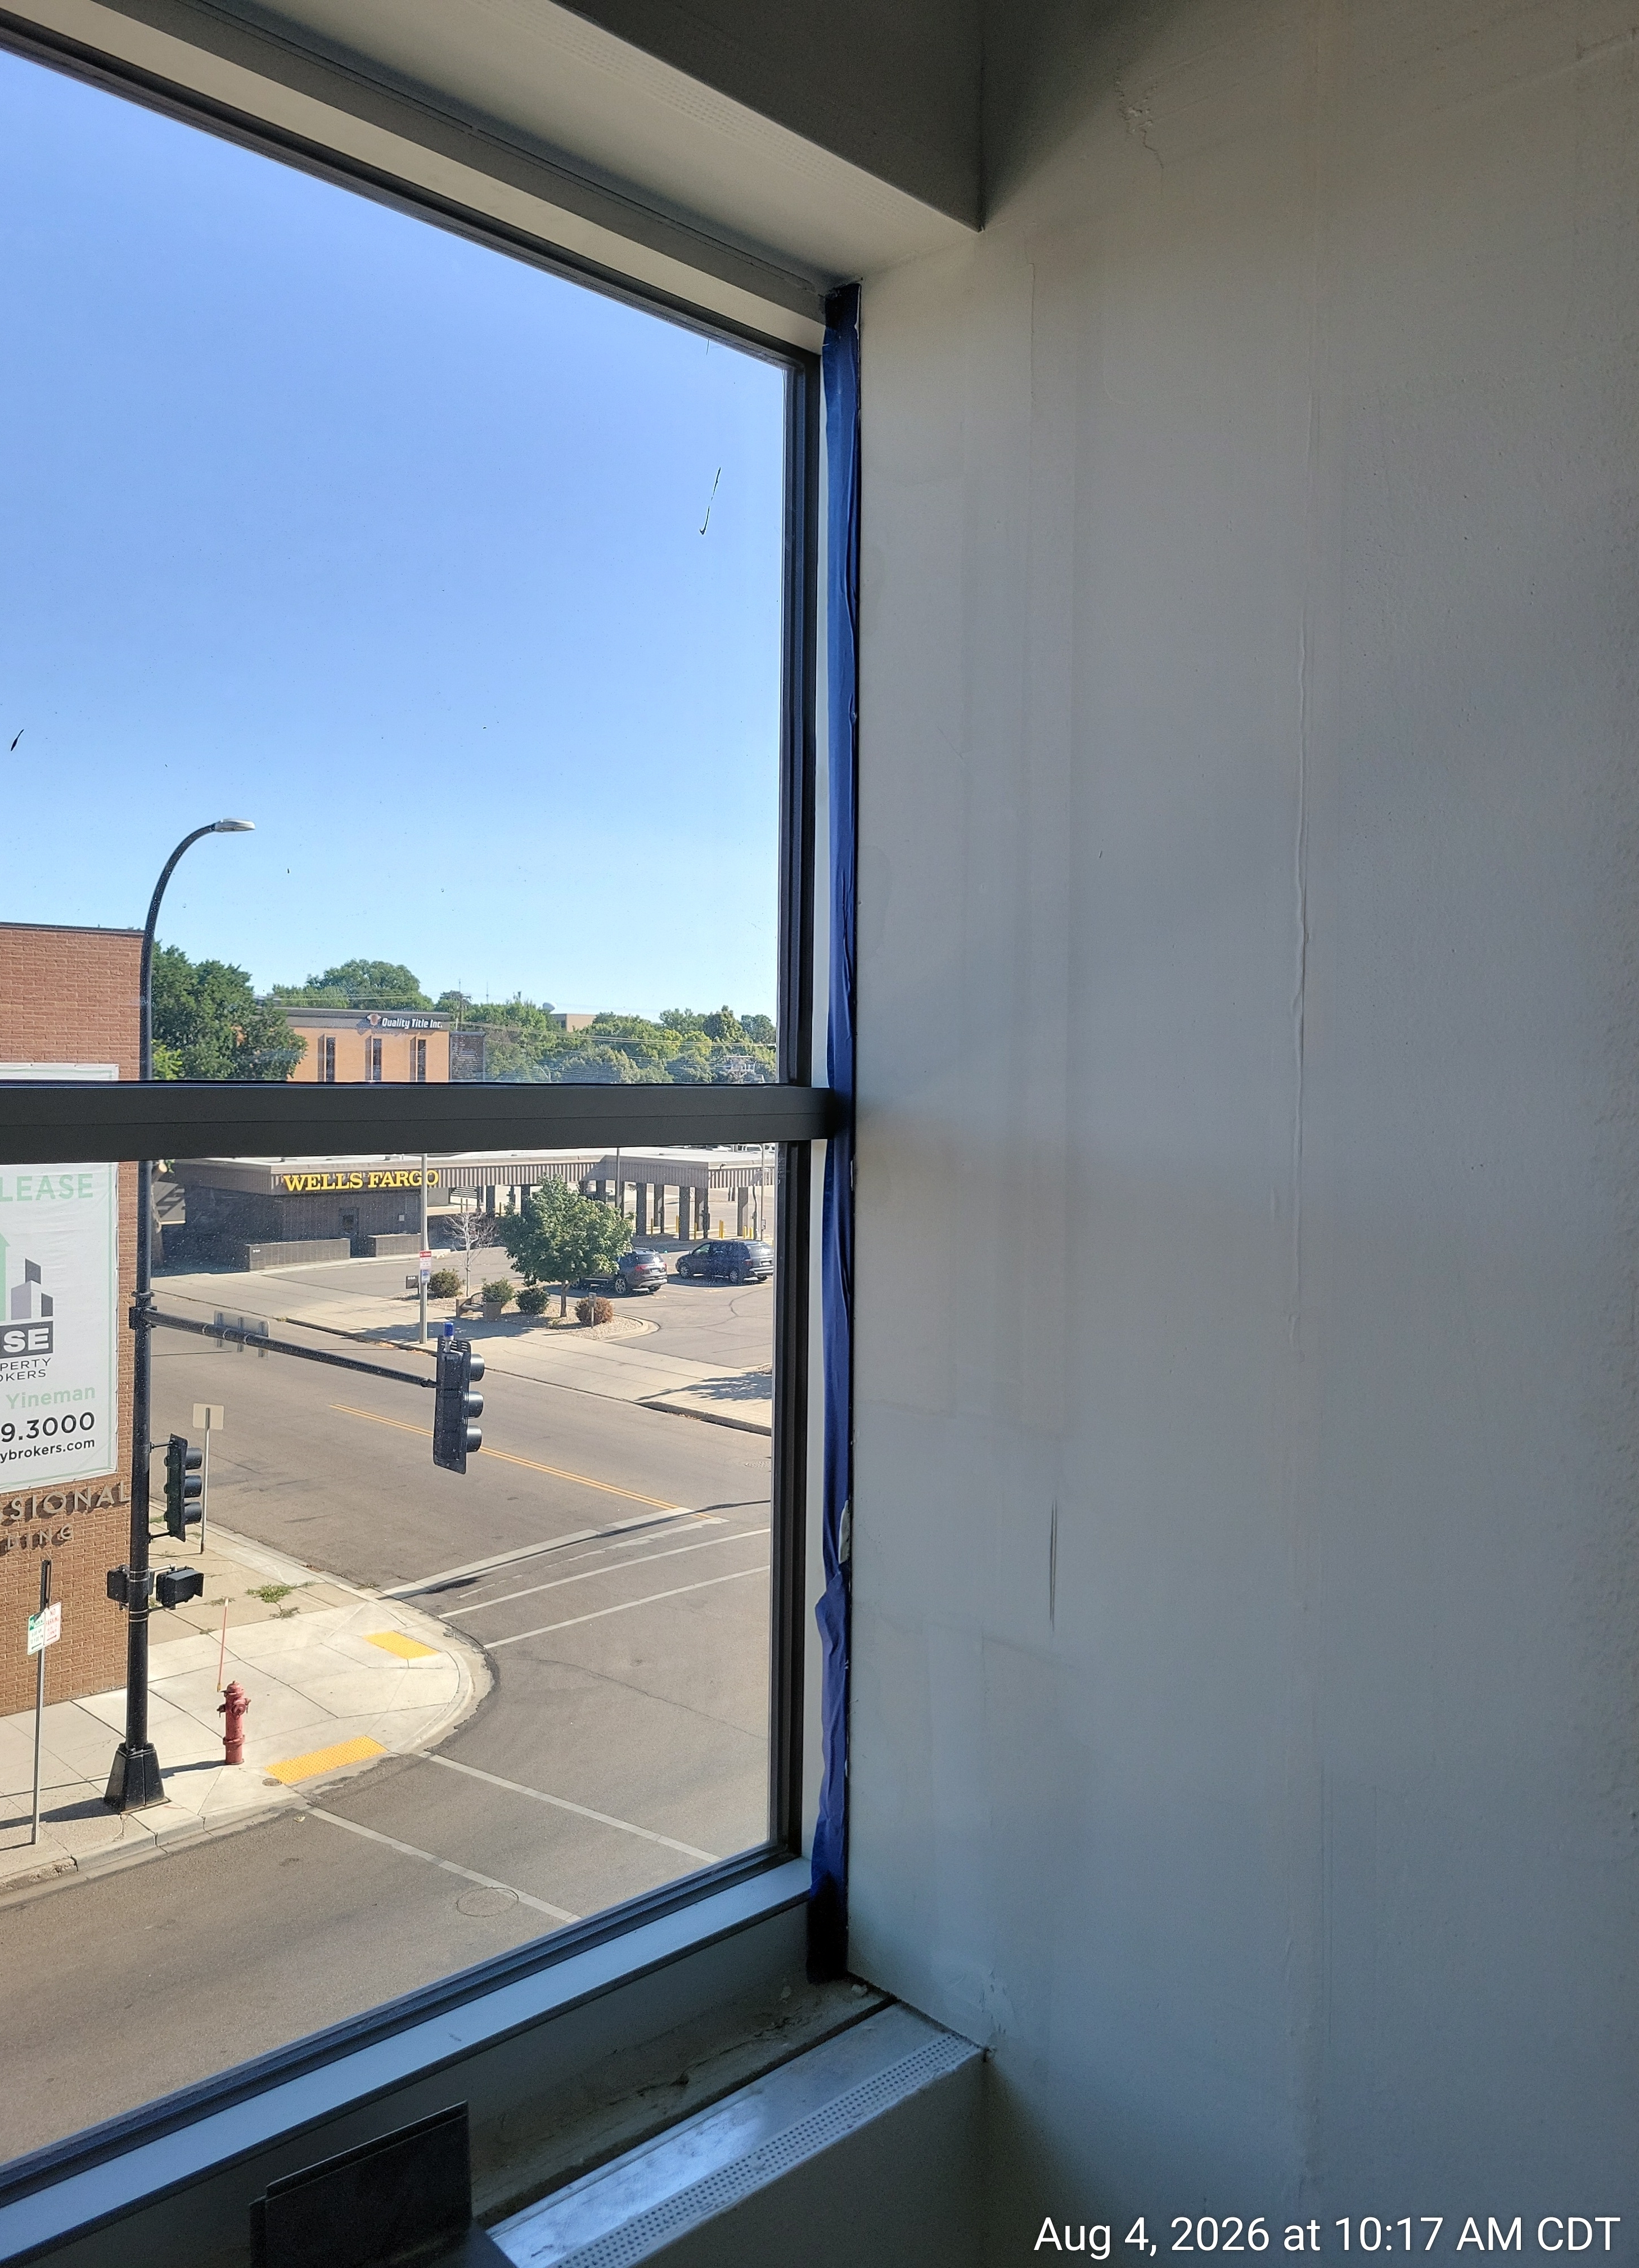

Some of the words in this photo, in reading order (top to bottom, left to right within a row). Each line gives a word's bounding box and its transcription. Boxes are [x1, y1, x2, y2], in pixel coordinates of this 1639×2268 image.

[382, 1018, 410, 1029] Quality
[412, 1018, 428, 1028] Title
[430, 1019, 443, 1028] Inc.
[0, 1173, 93, 1202] LEASE
[283, 1172, 363, 1191] WELLS
[368, 1169, 439, 1188] FARGO
[0, 1357, 51, 1371] PERTY
[6, 1386, 96, 1410] Yineman
[1, 1412, 95, 1443] 9.3000
[0, 1439, 95, 1464] ybrokers.com
[0, 1479, 131, 1520] SIONAL
